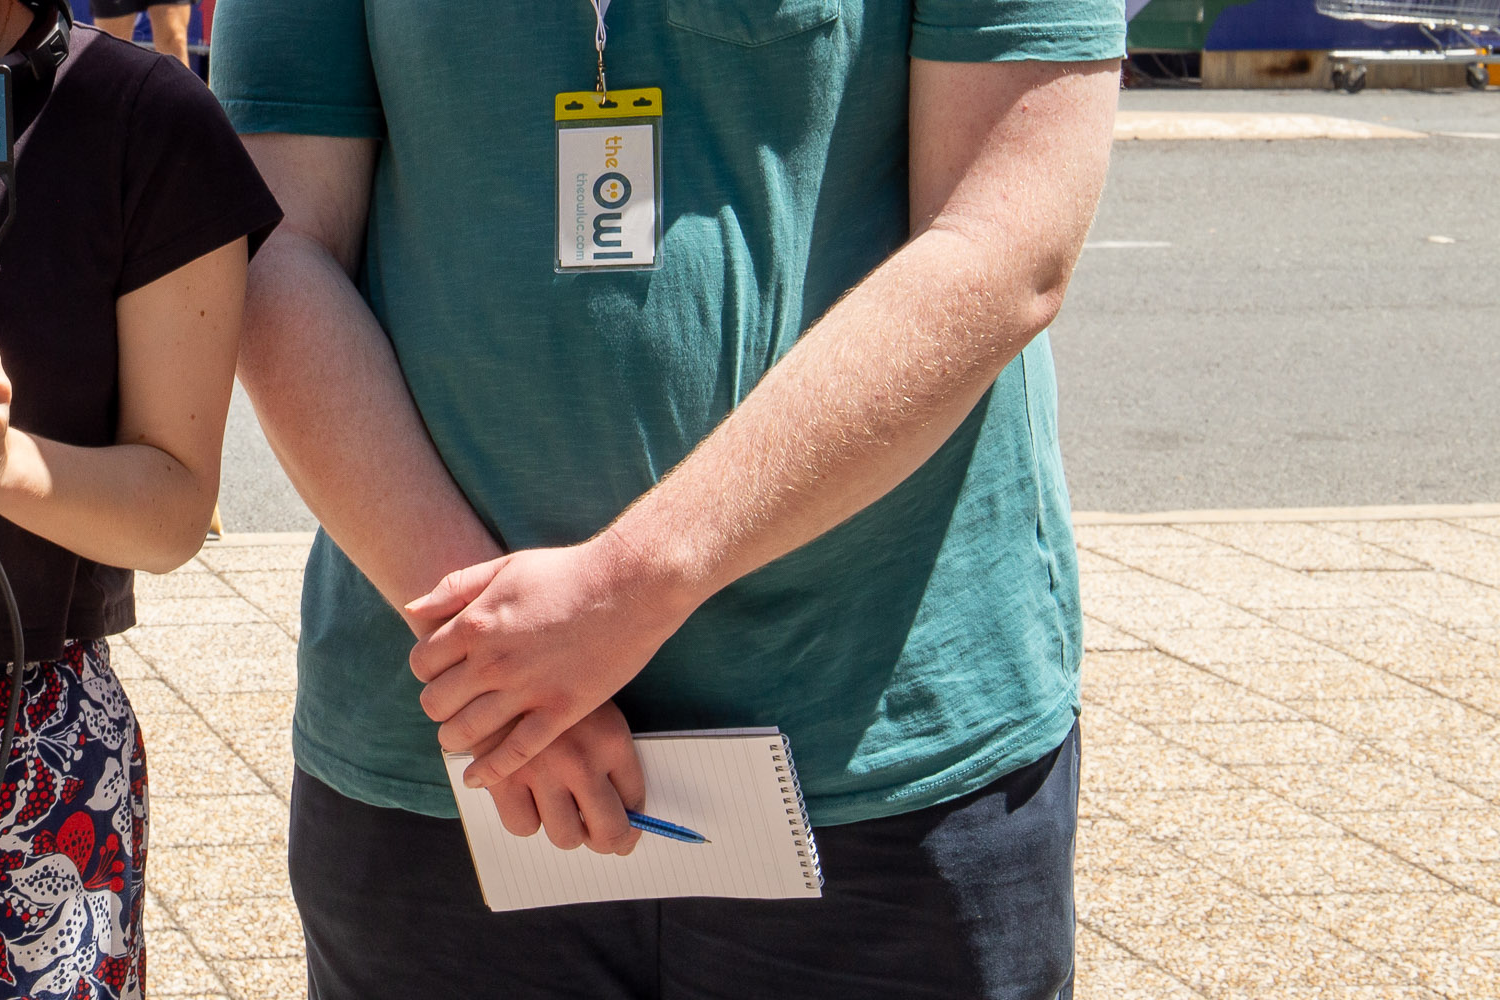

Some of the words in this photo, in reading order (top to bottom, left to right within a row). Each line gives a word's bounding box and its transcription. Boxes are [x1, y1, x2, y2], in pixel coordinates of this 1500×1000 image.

[605, 135, 622, 168] the
[575, 173, 588, 261] theowluc.com
[592, 172, 633, 260] Owl
